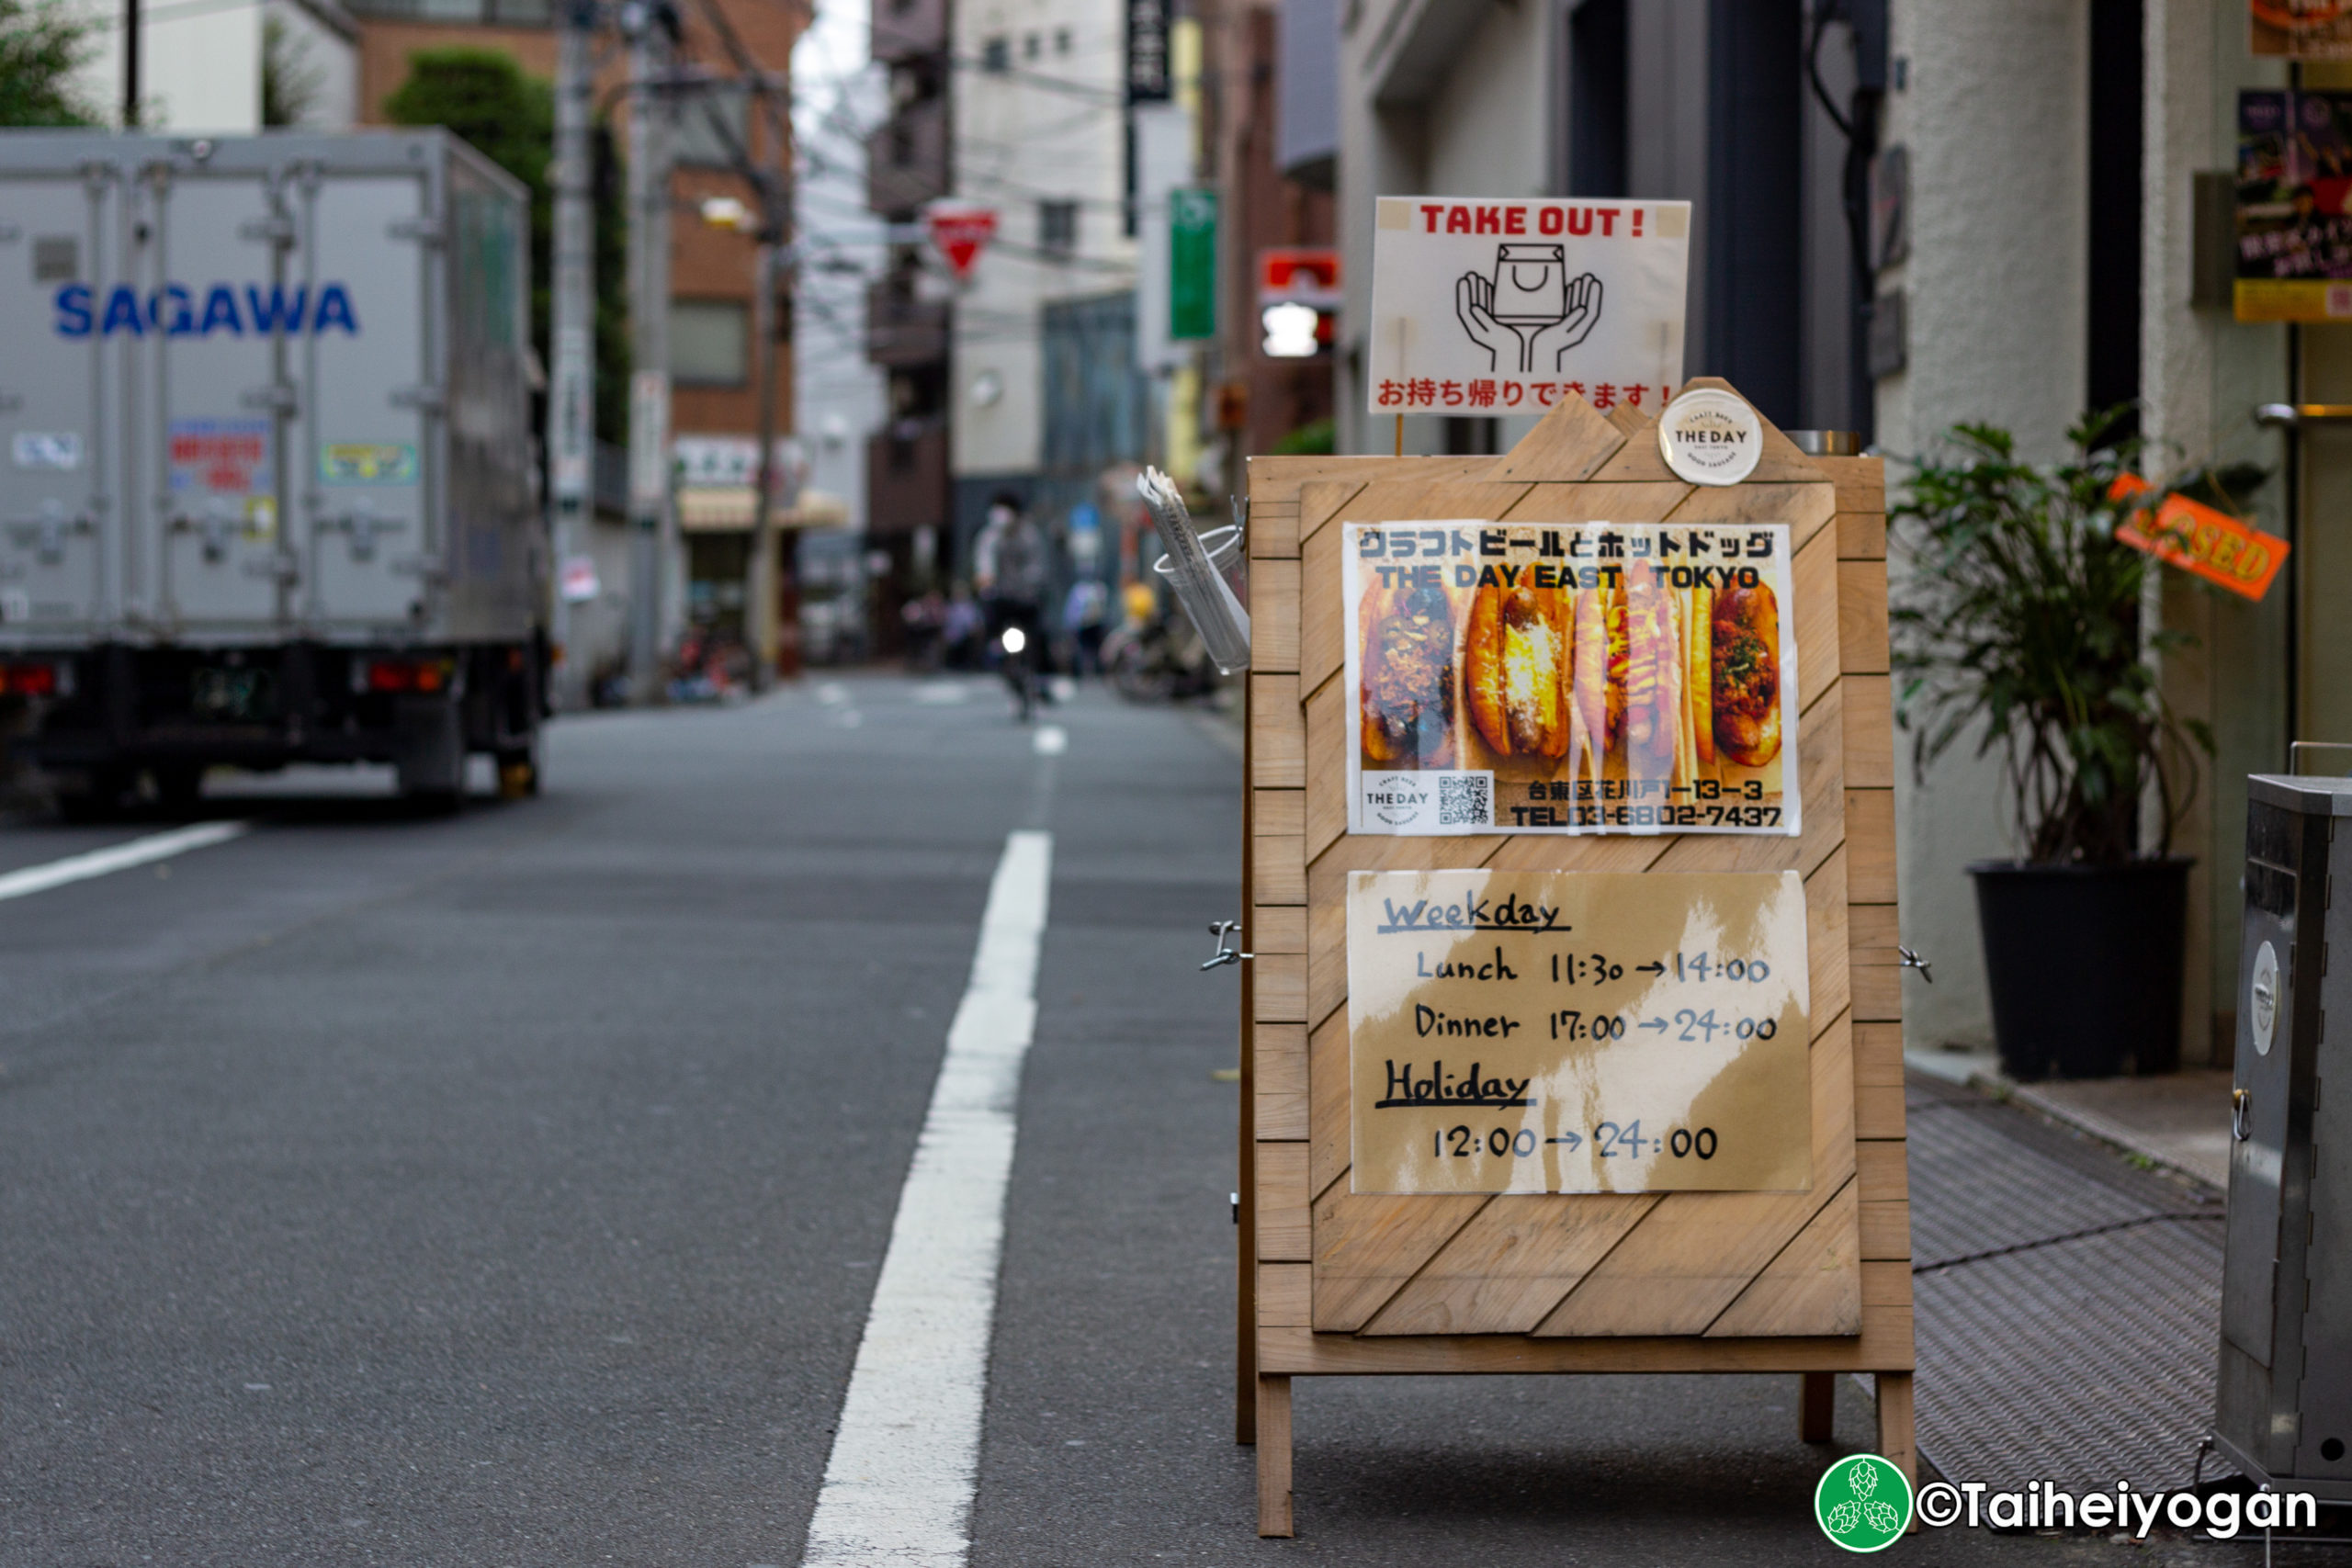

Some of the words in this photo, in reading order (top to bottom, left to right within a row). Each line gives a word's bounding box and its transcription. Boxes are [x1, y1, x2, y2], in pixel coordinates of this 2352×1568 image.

[1420, 205, 1527, 235] TAKE
[53, 283, 359, 337] SAGAWA
[1675, 430, 1706, 443] THE
[1711, 430, 1747, 444] DAY
[1360, 529, 1774, 558] クラフトビールとホットドッグ
[1375, 565, 1442, 589] THE
[1455, 564, 1521, 588] DAY
[1535, 565, 1622, 589] EAST
[1649, 566, 1759, 589] TOKYO
[1367, 793, 1394, 805] THE
[1396, 793, 1429, 805] DAY
[1383, 889, 1560, 934] Weekday
[1417, 946, 1519, 980] Lunch
[1551, 953, 1624, 986] 11:30
[1676, 951, 1771, 984] 14:00
[1415, 1003, 1521, 1038] Dinner
[1550, 1010, 1626, 1041] 17:00
[1674, 1008, 1778, 1043] 24:00
[1385, 1059, 1532, 1111] Holiday
[1434, 1124, 1537, 1158] 12:00
[1593, 1119, 1718, 1160] 24:00
